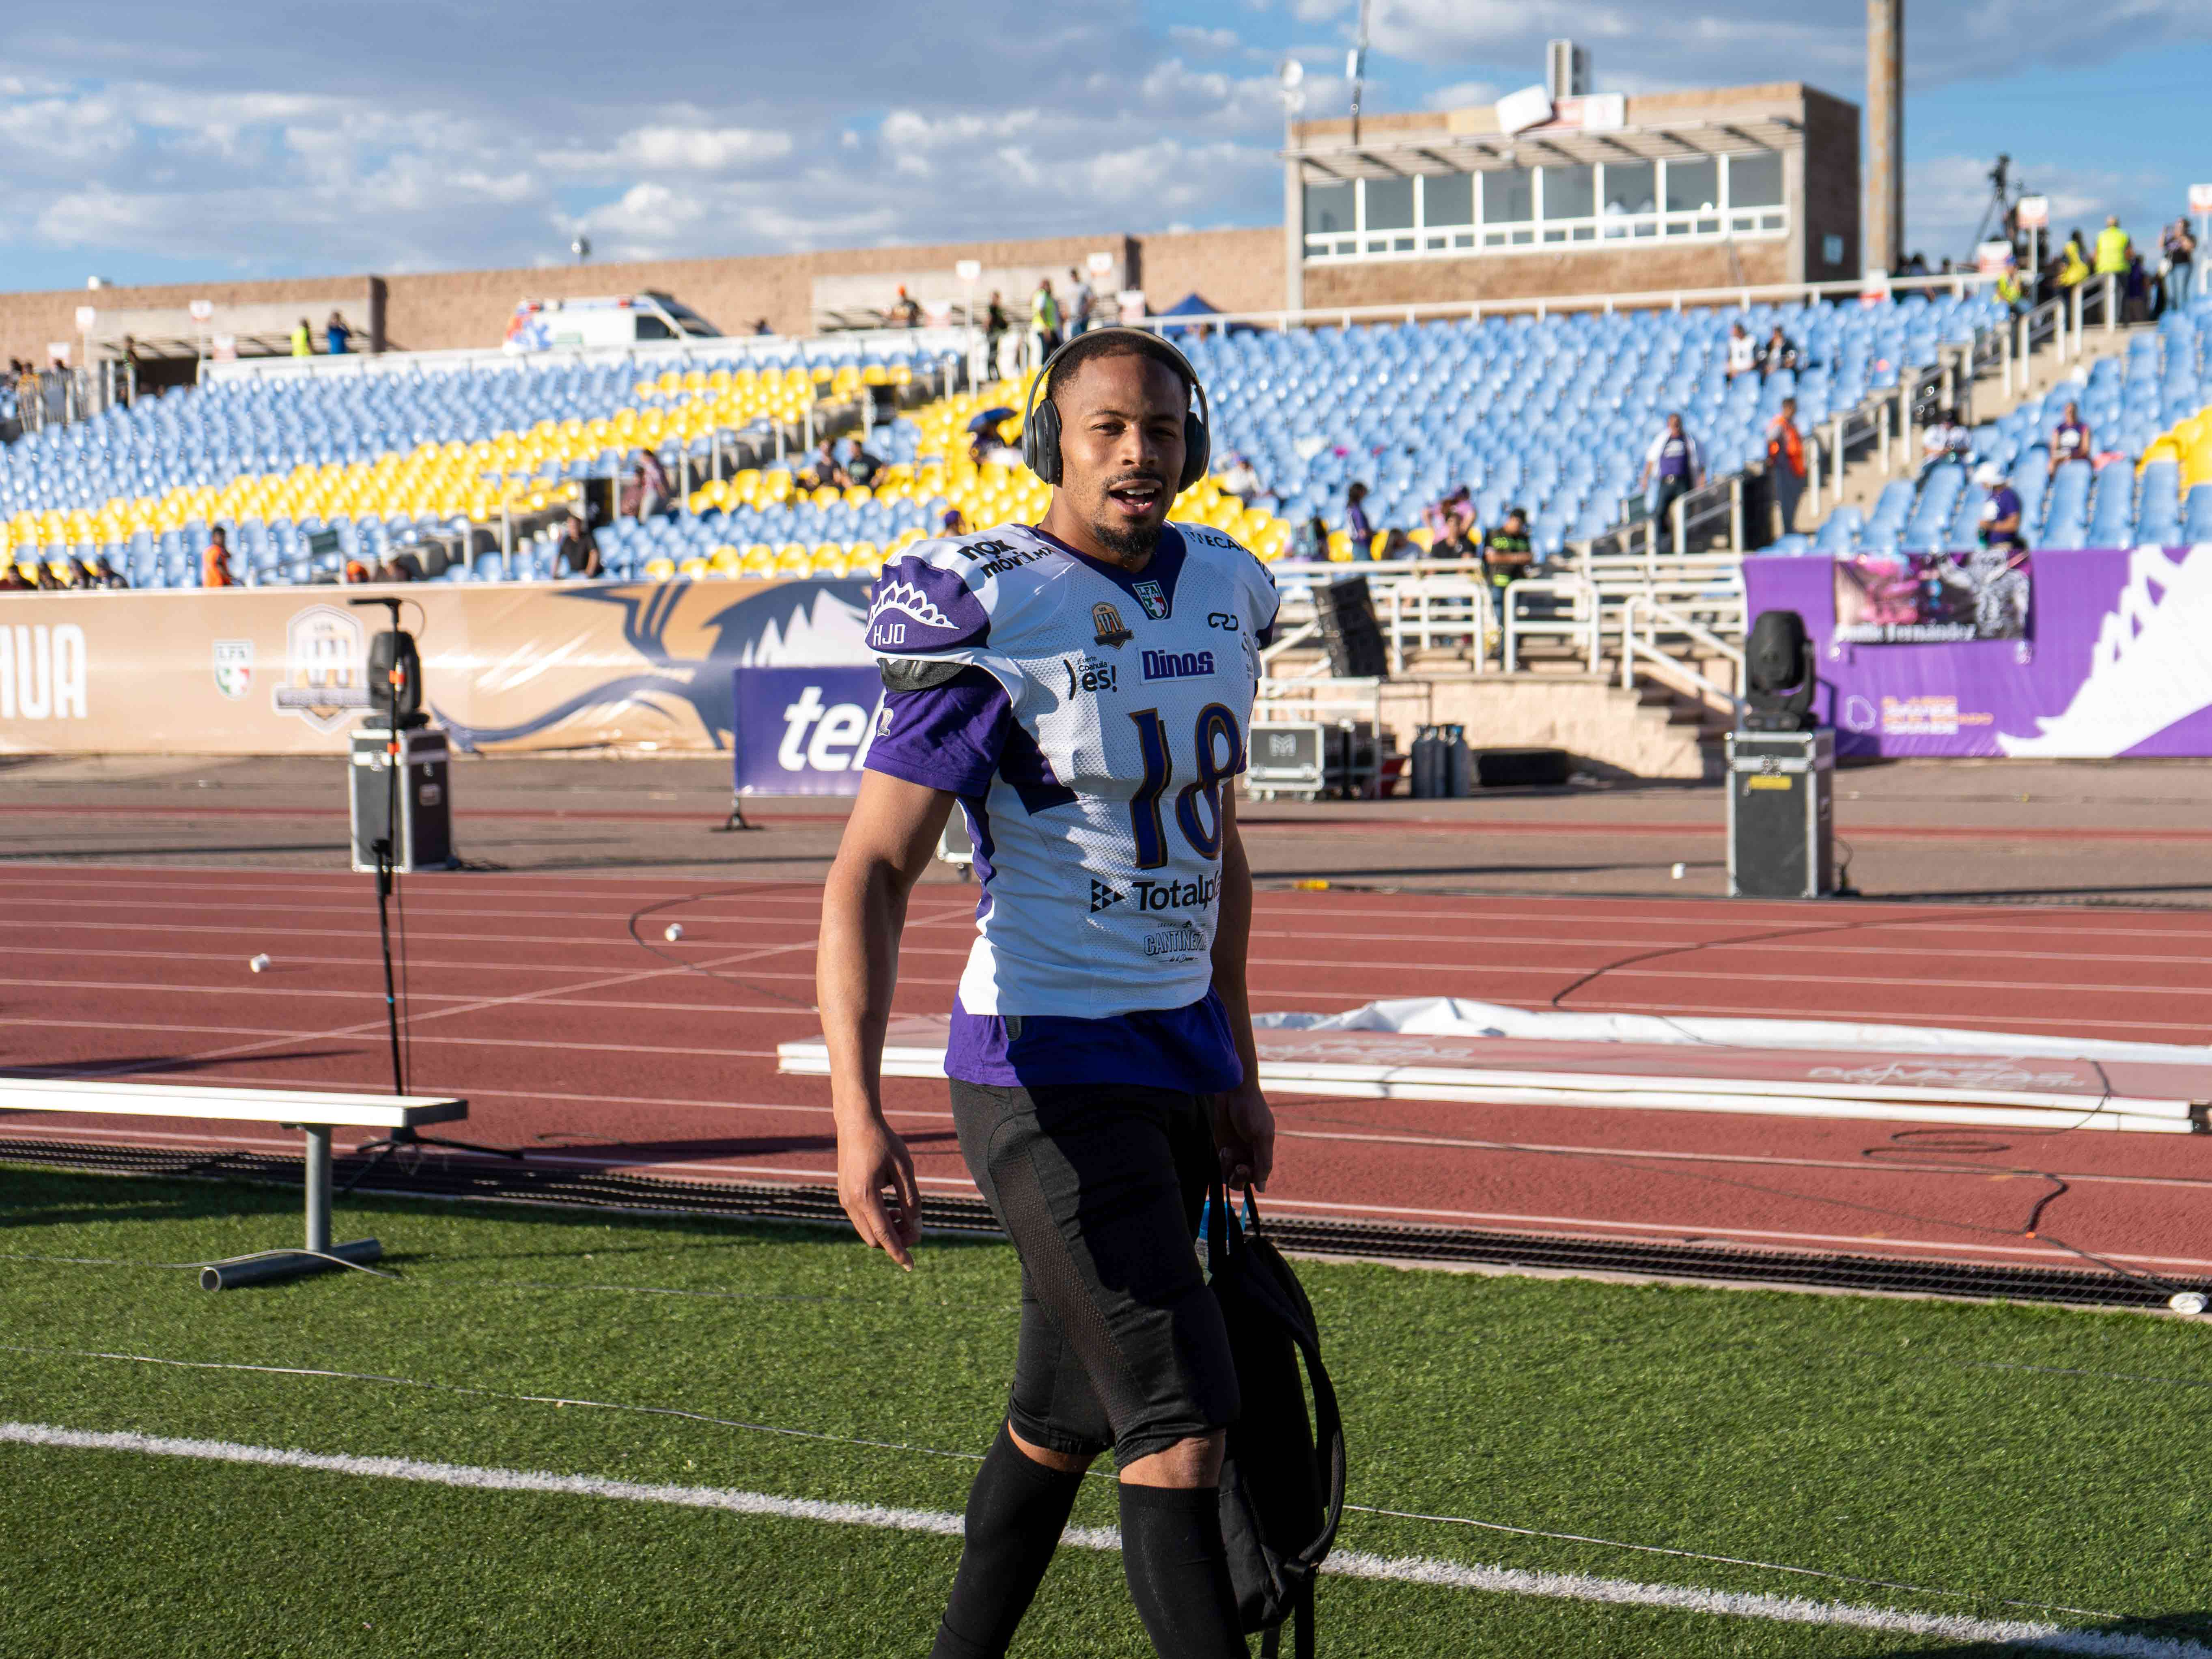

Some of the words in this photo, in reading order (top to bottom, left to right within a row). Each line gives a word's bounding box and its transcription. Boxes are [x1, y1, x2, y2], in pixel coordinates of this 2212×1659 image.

[956, 539, 1018, 561] nox
[1082, 665, 1117, 692] es!
[1142, 650, 1215, 679] Dinos
[1129, 702, 1242, 870] 18
